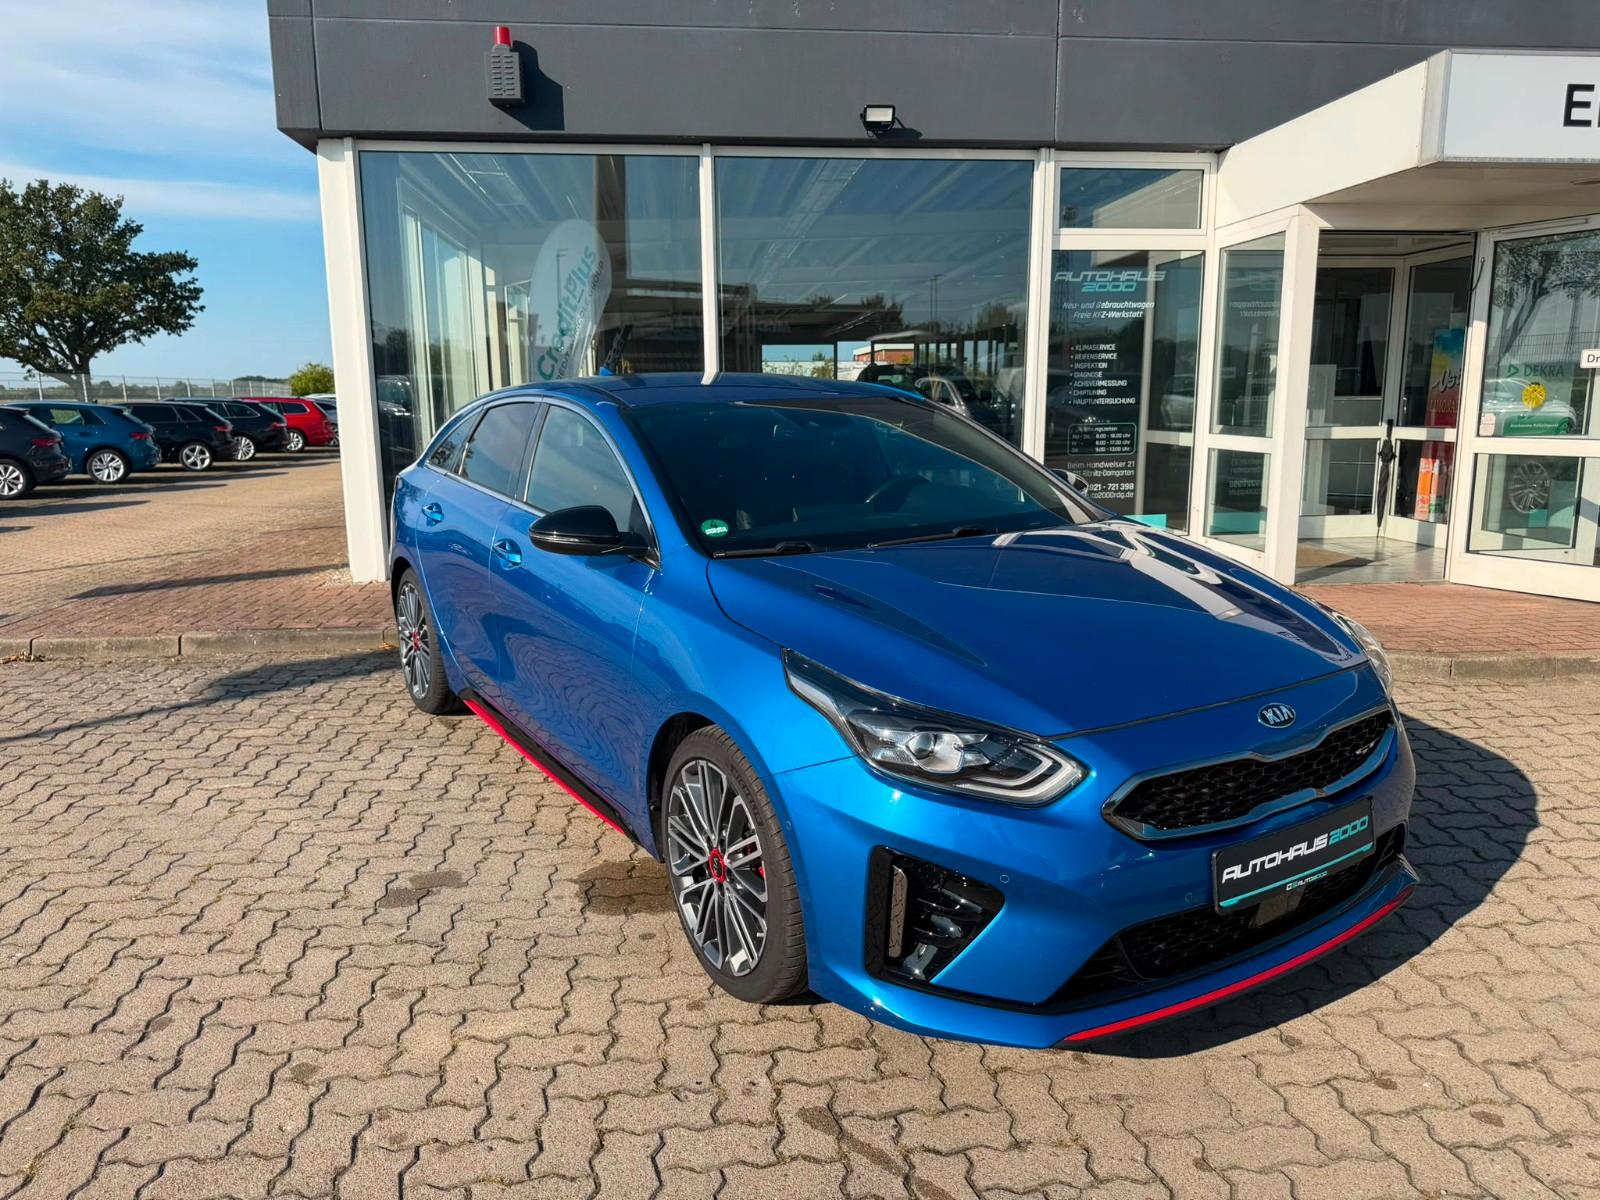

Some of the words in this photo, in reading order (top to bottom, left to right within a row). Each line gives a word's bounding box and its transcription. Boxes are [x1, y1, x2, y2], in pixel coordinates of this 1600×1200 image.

[1563, 83, 1600, 127] E
[1054, 271, 1167, 281] AUTOHAUS
[1081, 282, 1137, 292] 2000
[1062, 301, 1080, 309] Neu-
[1081, 301, 1098, 309] und
[1098, 301, 1155, 310] Gebrauchtwagen
[537, 247, 596, 381] CreditPlus
[1073, 311, 1092, 319] Freie
[1092, 310, 1144, 319] KFZ-Werkstatt
[1524, 364, 1564, 377] DEKRA
[1072, 397, 1136, 405] HAUPTUNTERSUCHUNG
[1086, 460, 1126, 469] Handweiser
[1127, 460, 1135, 468] 21
[1107, 483, 1119, 491] 721
[1120, 482, 1135, 491] 398
[1261, 706, 1294, 725] KIA
